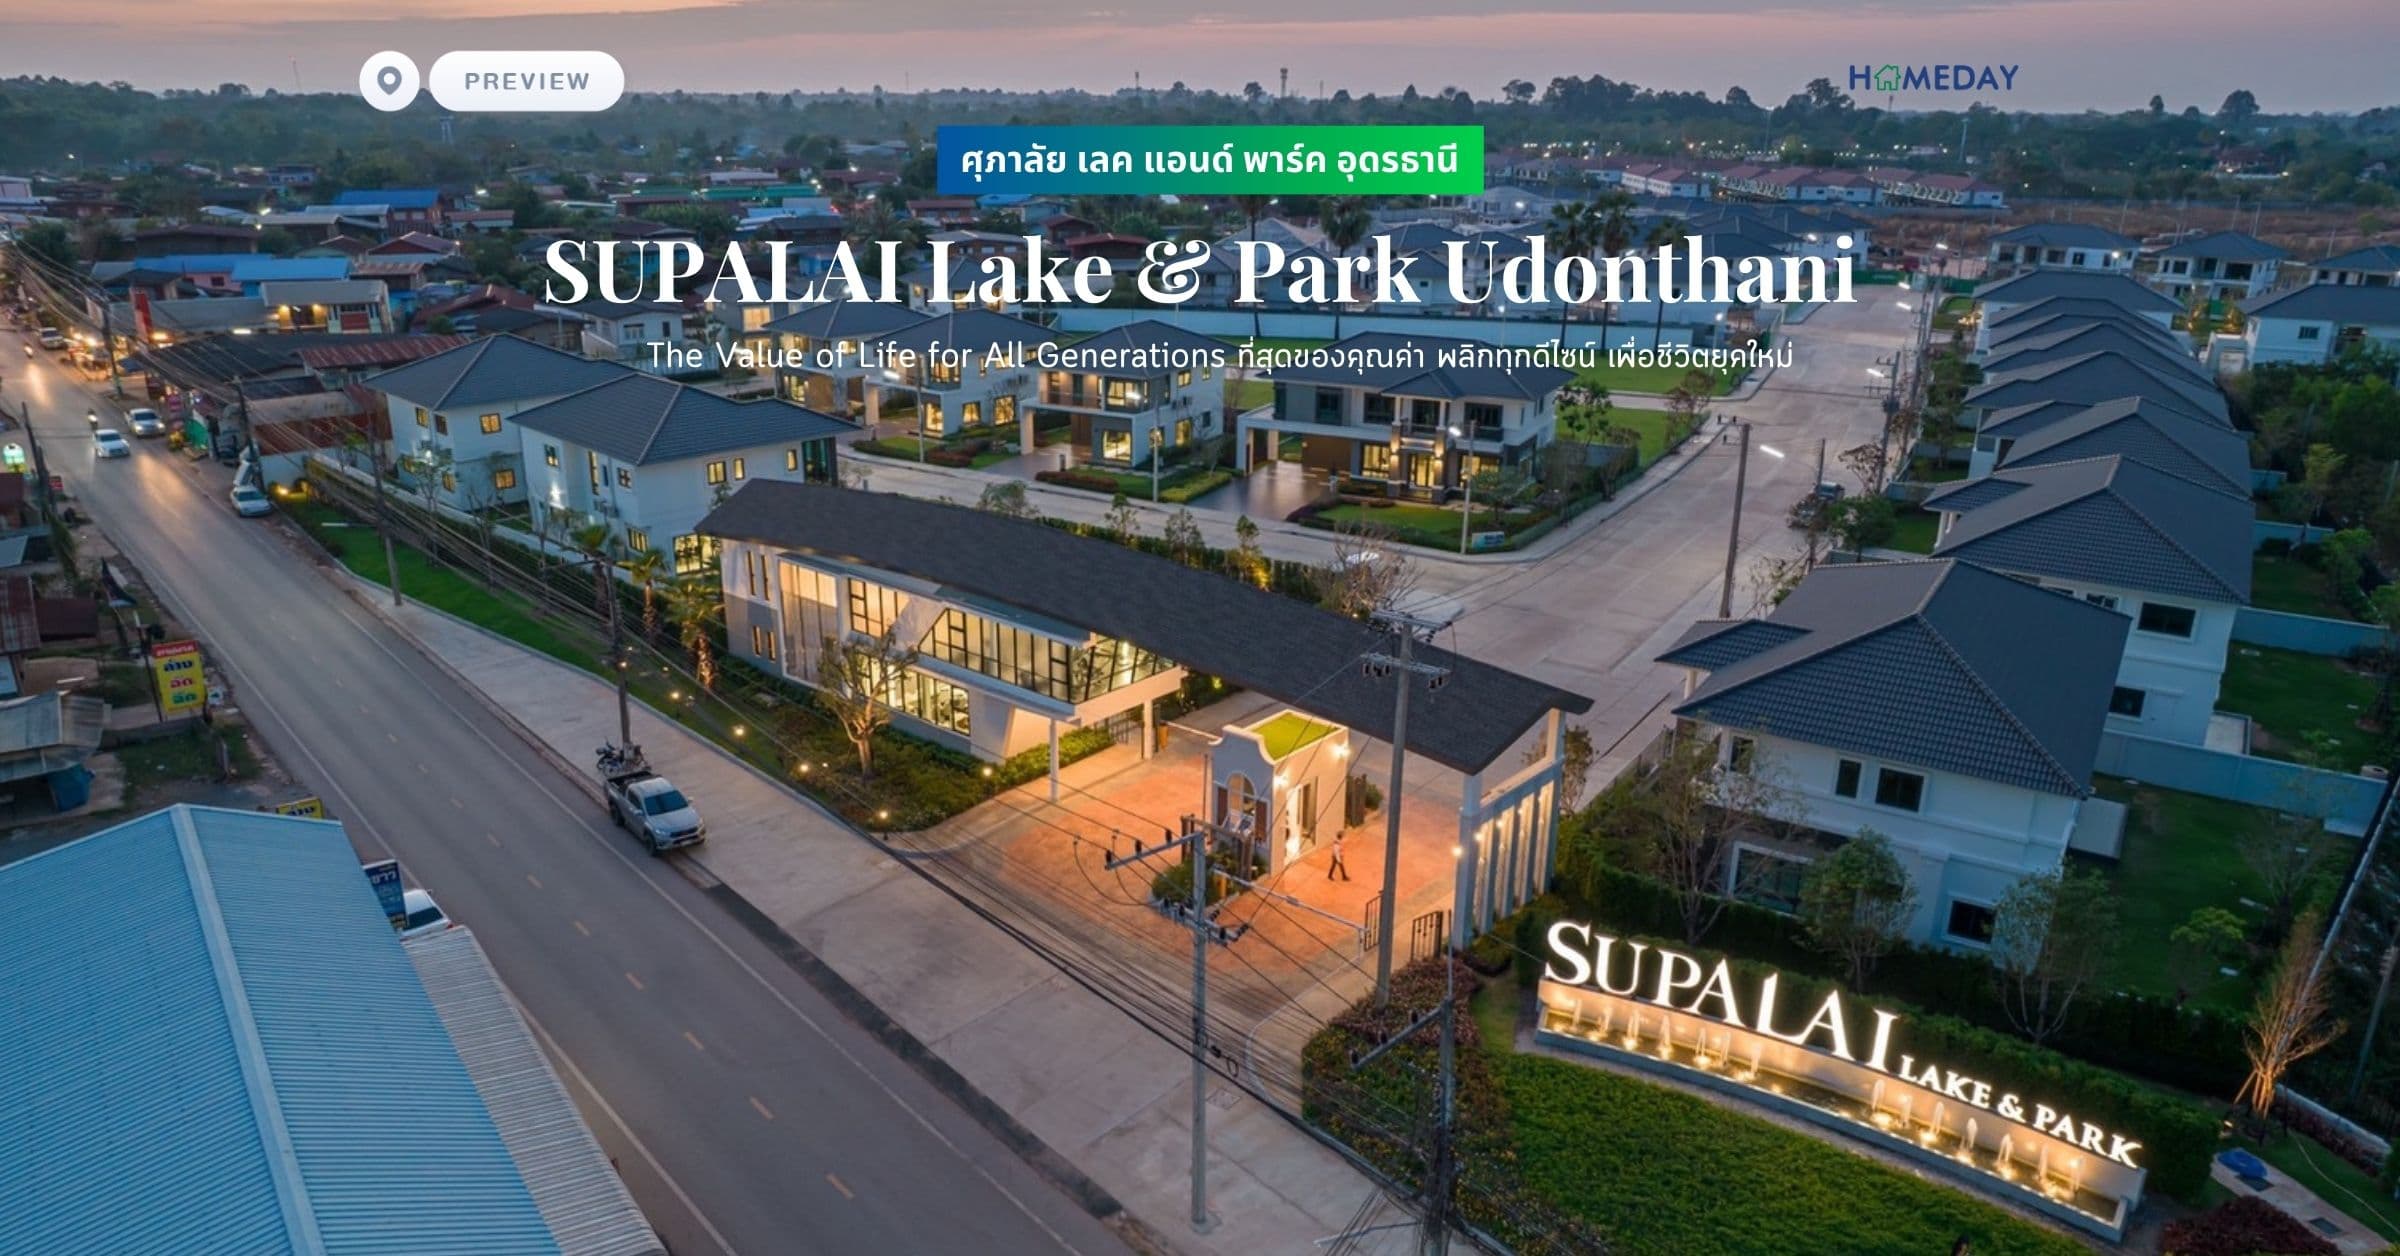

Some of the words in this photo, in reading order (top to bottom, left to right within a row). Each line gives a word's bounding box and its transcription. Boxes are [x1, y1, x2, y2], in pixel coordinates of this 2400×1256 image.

[1543, 920, 1898, 1073] SUPALAI
[1898, 1054, 1993, 1109] LAKE
[1997, 1093, 2027, 1124] &
[2033, 1103, 2143, 1169] PARK
